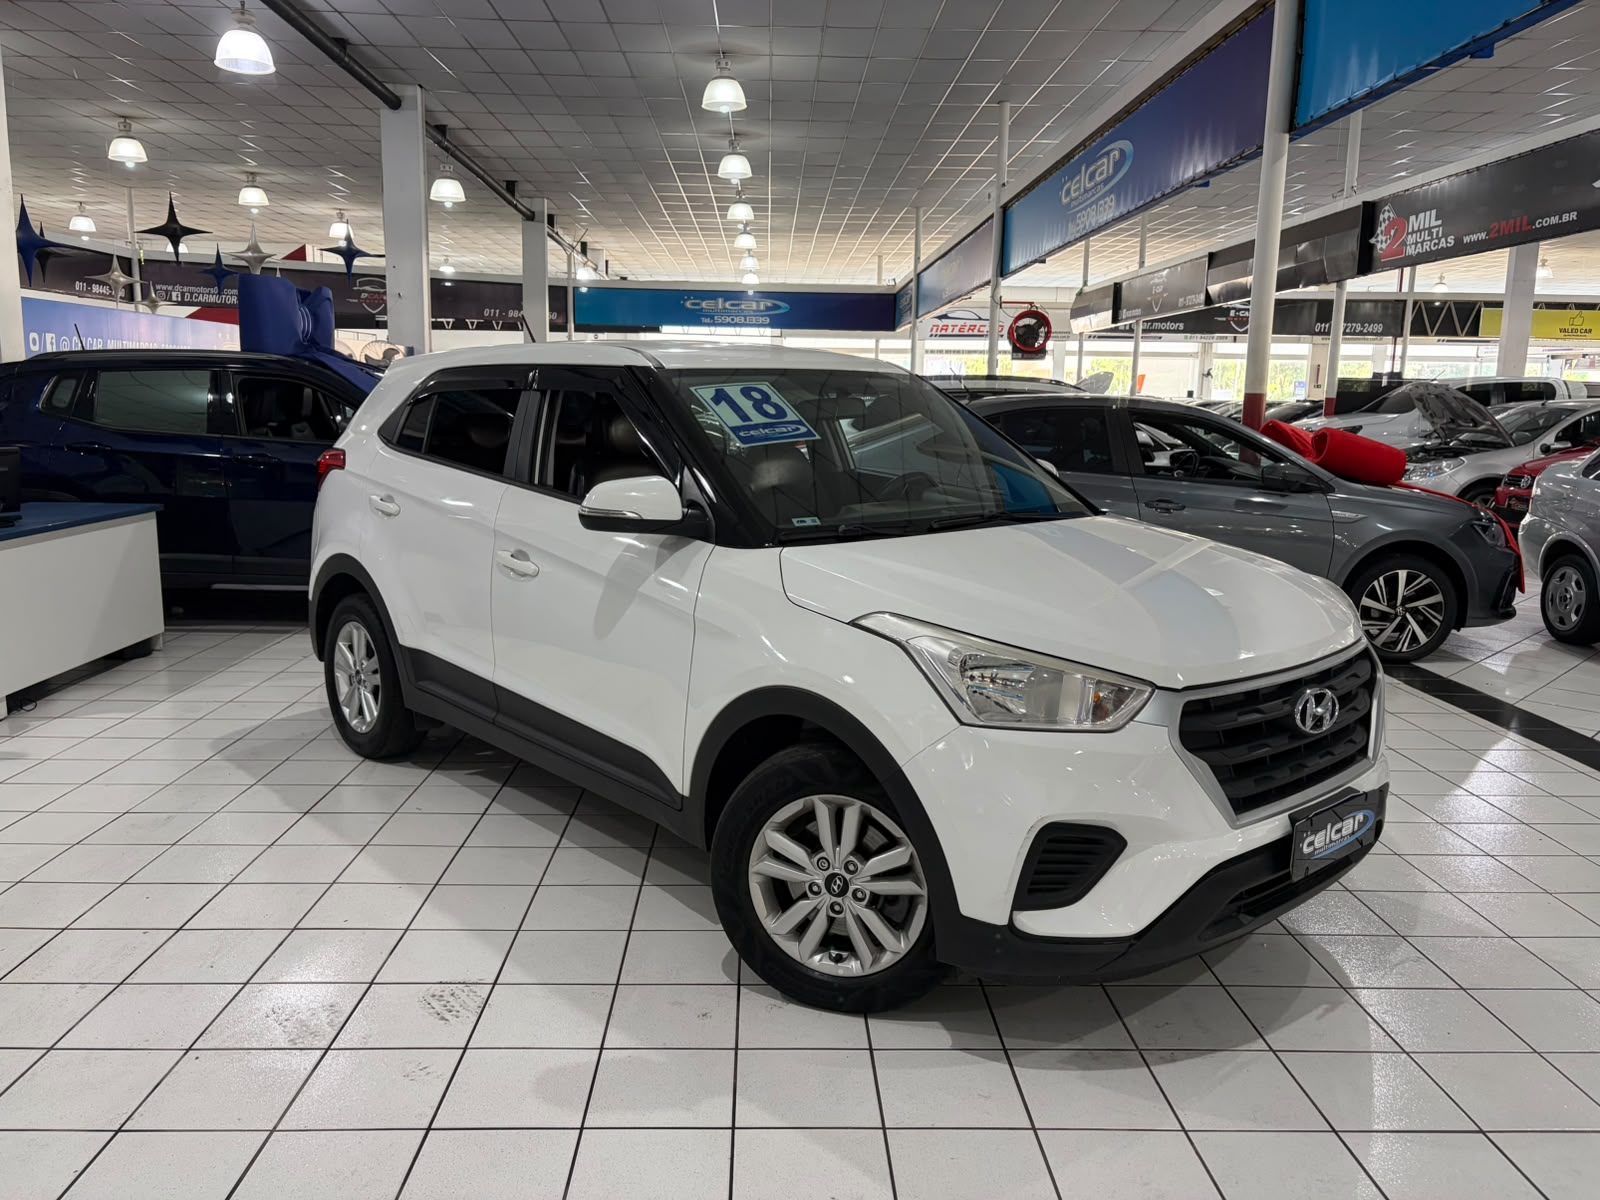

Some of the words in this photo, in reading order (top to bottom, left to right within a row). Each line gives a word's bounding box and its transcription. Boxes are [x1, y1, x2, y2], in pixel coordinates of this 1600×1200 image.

[1061, 149, 1121, 206] celcar
[1408, 209, 1442, 233] MIL
[1406, 226, 1443, 246] MULTI
[1406, 235, 1455, 257] MARCAS
[75, 281, 87, 292] 011
[483, 308, 500, 317] 011
[684, 297, 773, 311] celcar
[1314, 322, 1330, 332] 011
[710, 386, 788, 423] 18
[739, 425, 797, 437] celcar
[1302, 812, 1364, 855] celcar
